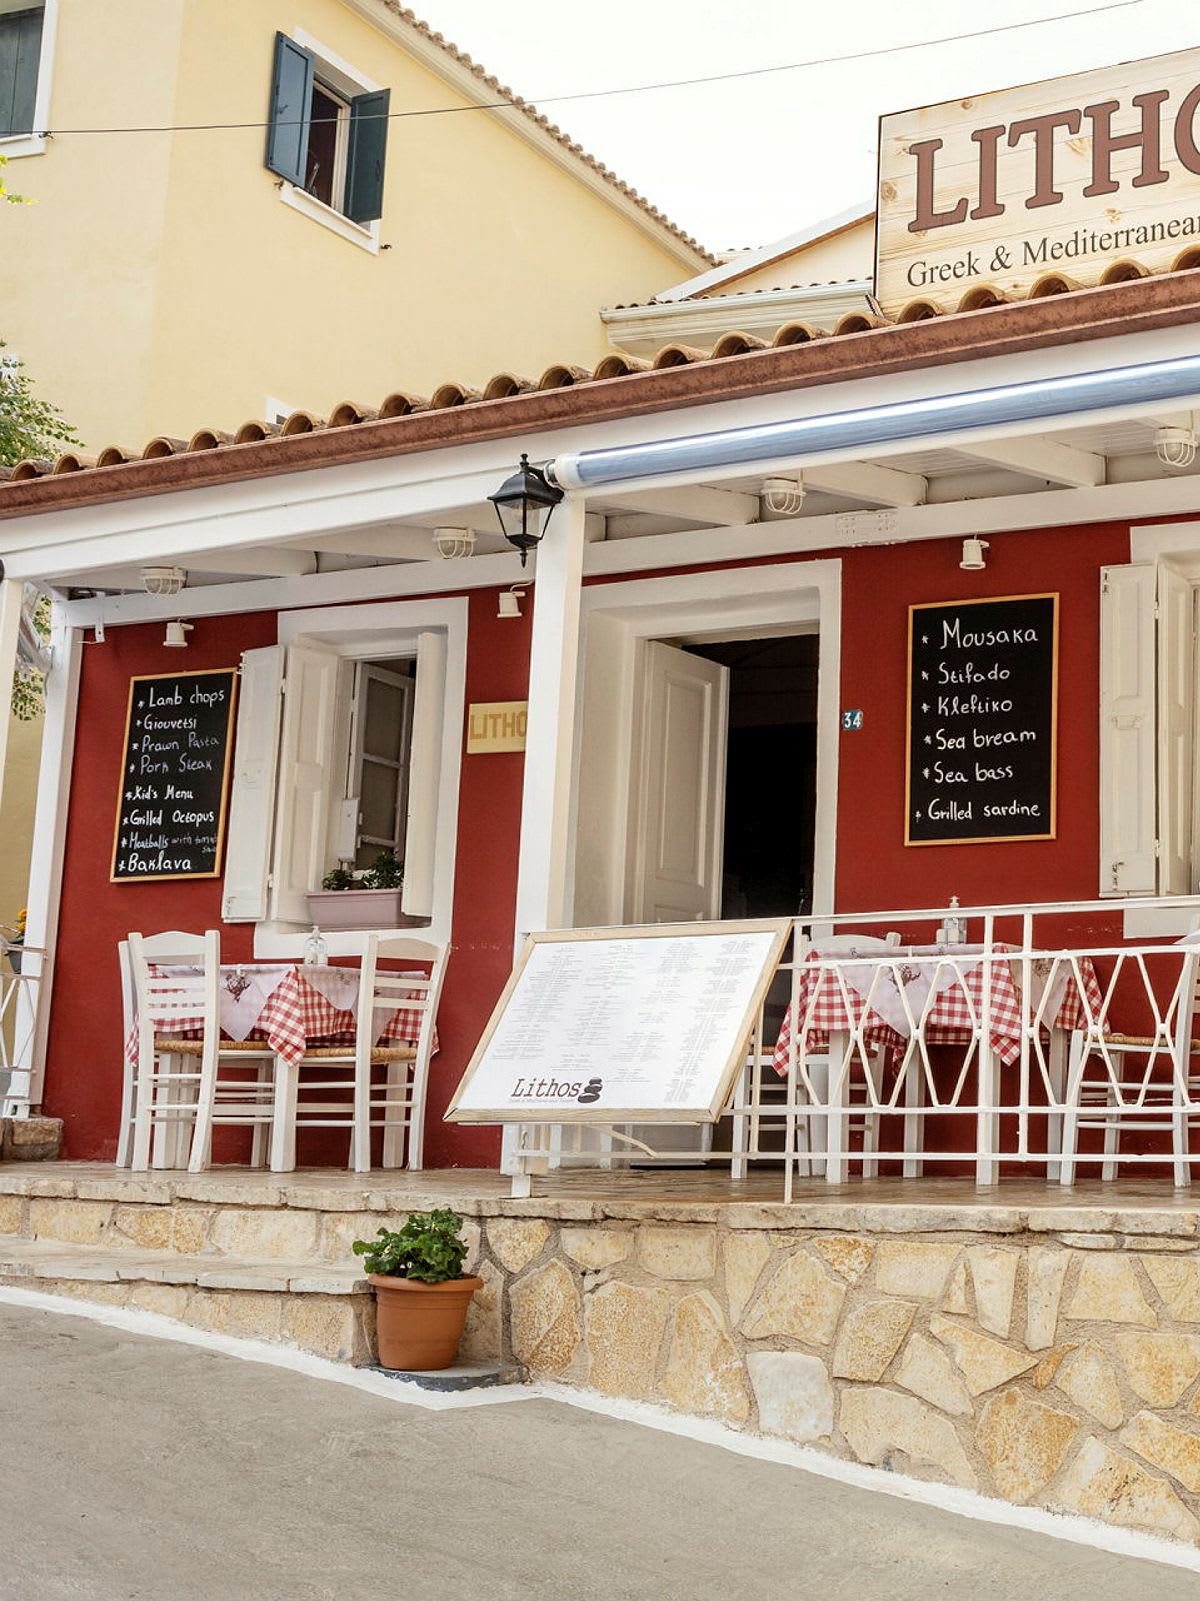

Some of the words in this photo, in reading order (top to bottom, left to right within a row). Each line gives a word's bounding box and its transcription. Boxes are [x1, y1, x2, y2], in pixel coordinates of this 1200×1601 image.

[907, 246, 981, 287] Greek
[989, 245, 1012, 272] &
[940, 617, 1039, 650] Mousaka
[937, 661, 1011, 685] Stifado
[149, 685, 183, 707] Lamb
[189, 684, 225, 708] chops
[937, 694, 1013, 716] Kleftiko
[143, 713, 197, 730] Giouvetsi
[844, 711, 862, 729] 34
[142, 735, 180, 753] Prawn
[188, 731, 220, 749] Pasta
[935, 728, 966, 750] Sea
[973, 728, 1037, 749] bream
[933, 761, 969, 784] Sea
[975, 762, 1014, 782] bass
[164, 784, 194, 800] Menu
[129, 809, 163, 827] Grilled
[172, 809, 215, 828] Octopus
[927, 798, 973, 821] Grilled
[983, 799, 1041, 818] sardine
[128, 849, 192, 872] Baklava
[510, 1077, 583, 1098] Lithos
